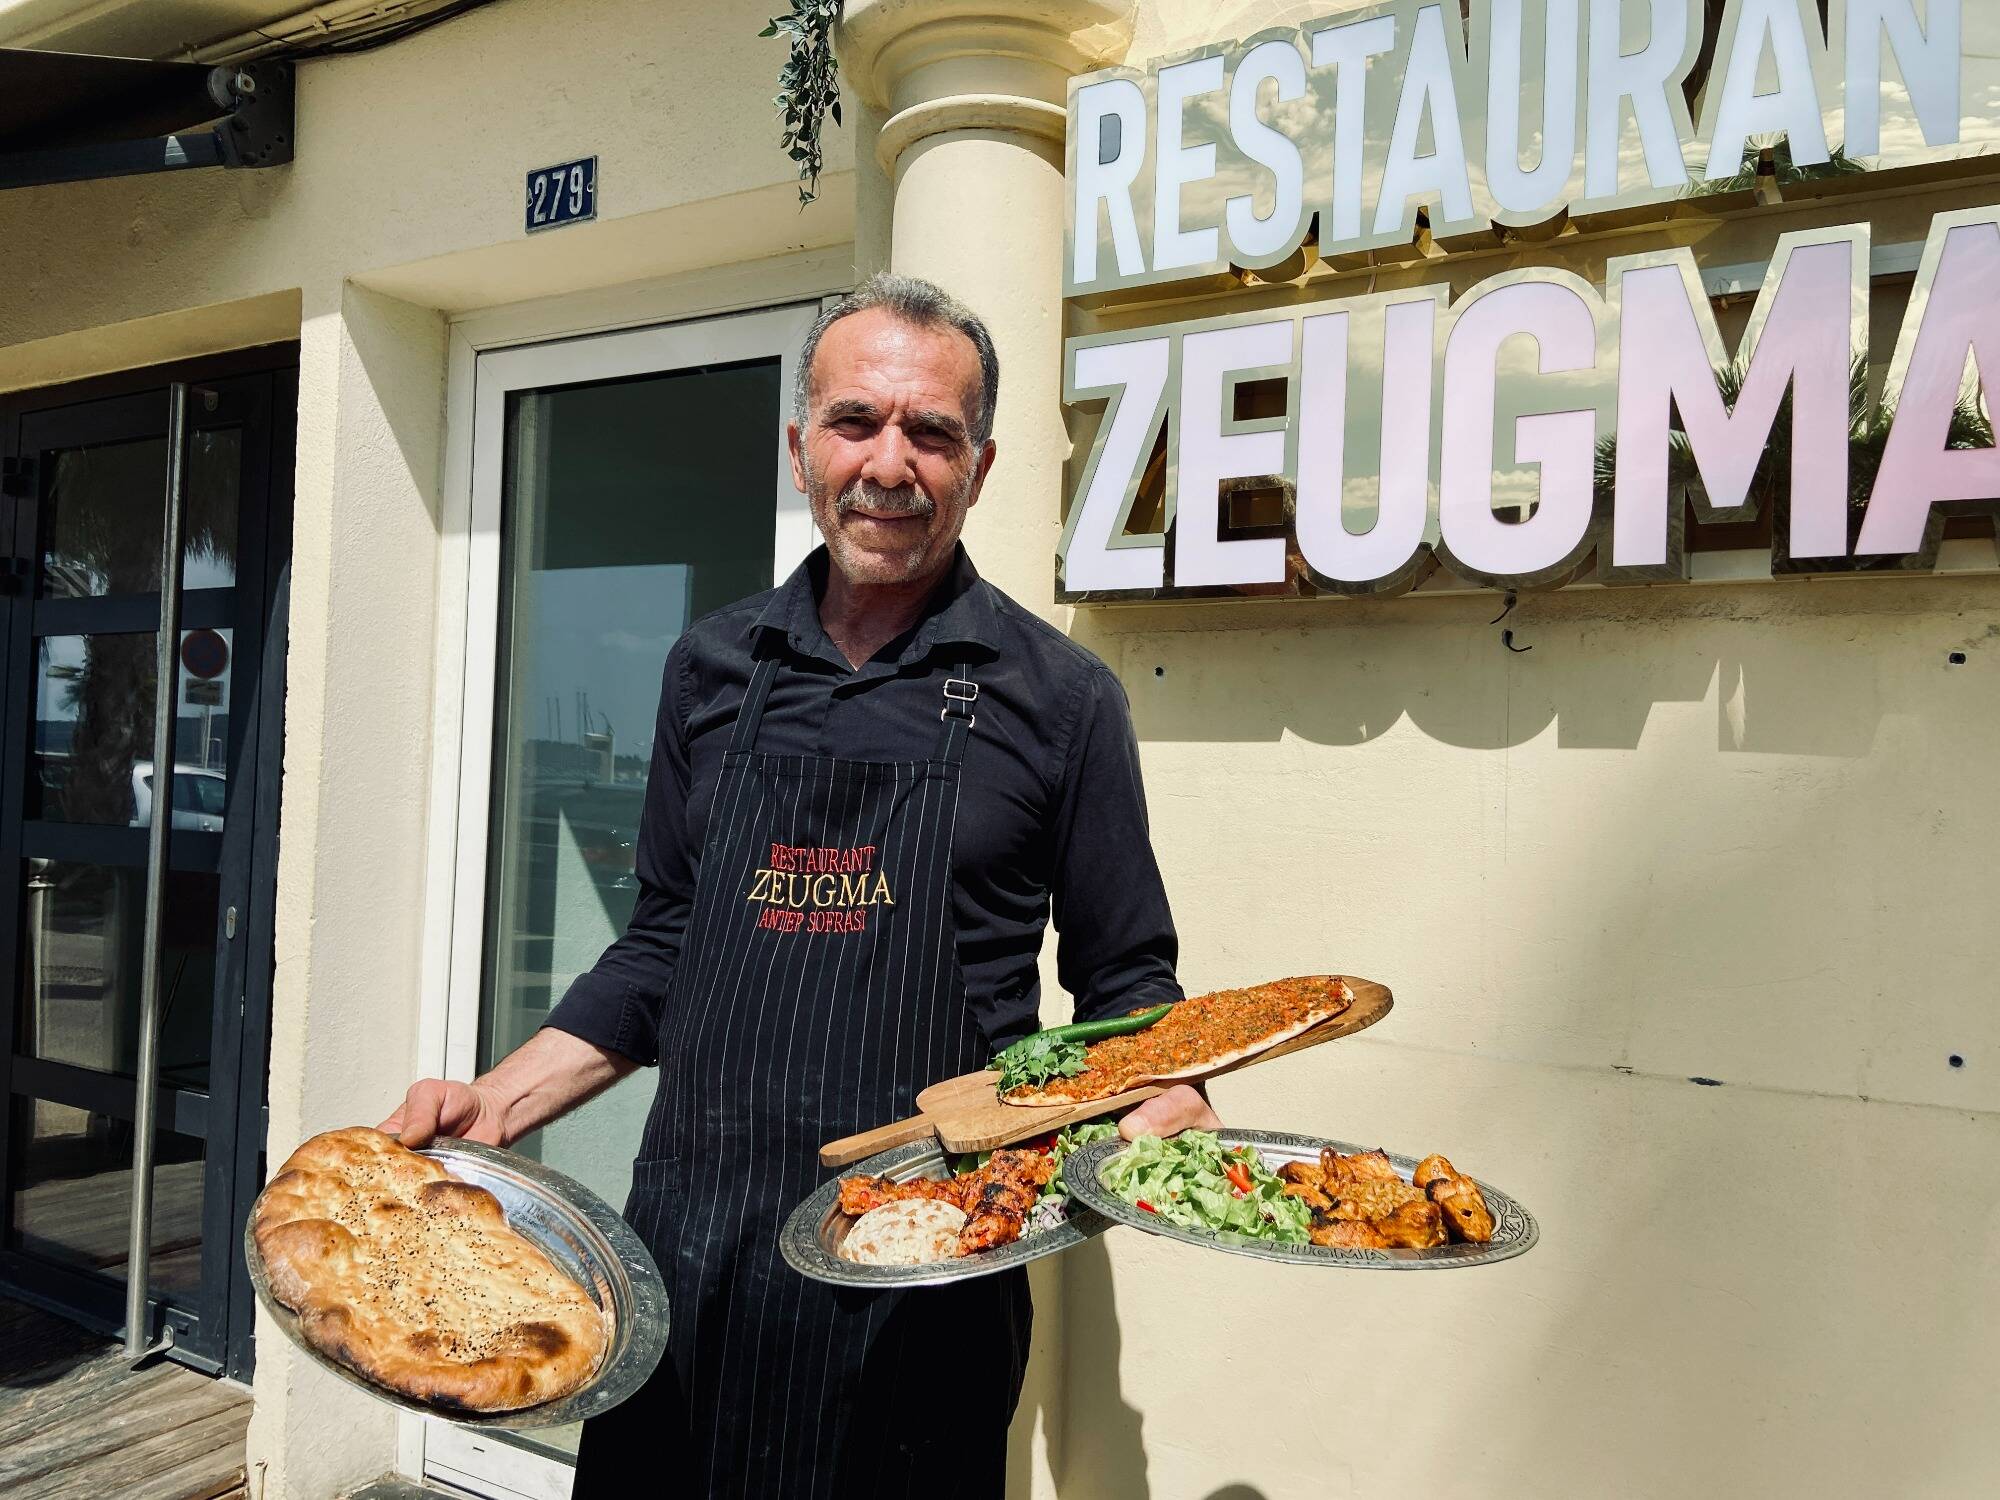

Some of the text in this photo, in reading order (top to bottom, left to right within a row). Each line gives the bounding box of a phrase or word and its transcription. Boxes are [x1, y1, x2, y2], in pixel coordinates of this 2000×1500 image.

[533, 165, 584, 223] 279
[1065, 222, 2000, 592] ZEUGMA
[770, 843, 876, 872] RESTAURANT
[748, 869, 894, 908] ZEUGMA
[759, 907, 805, 932] ANTEP
